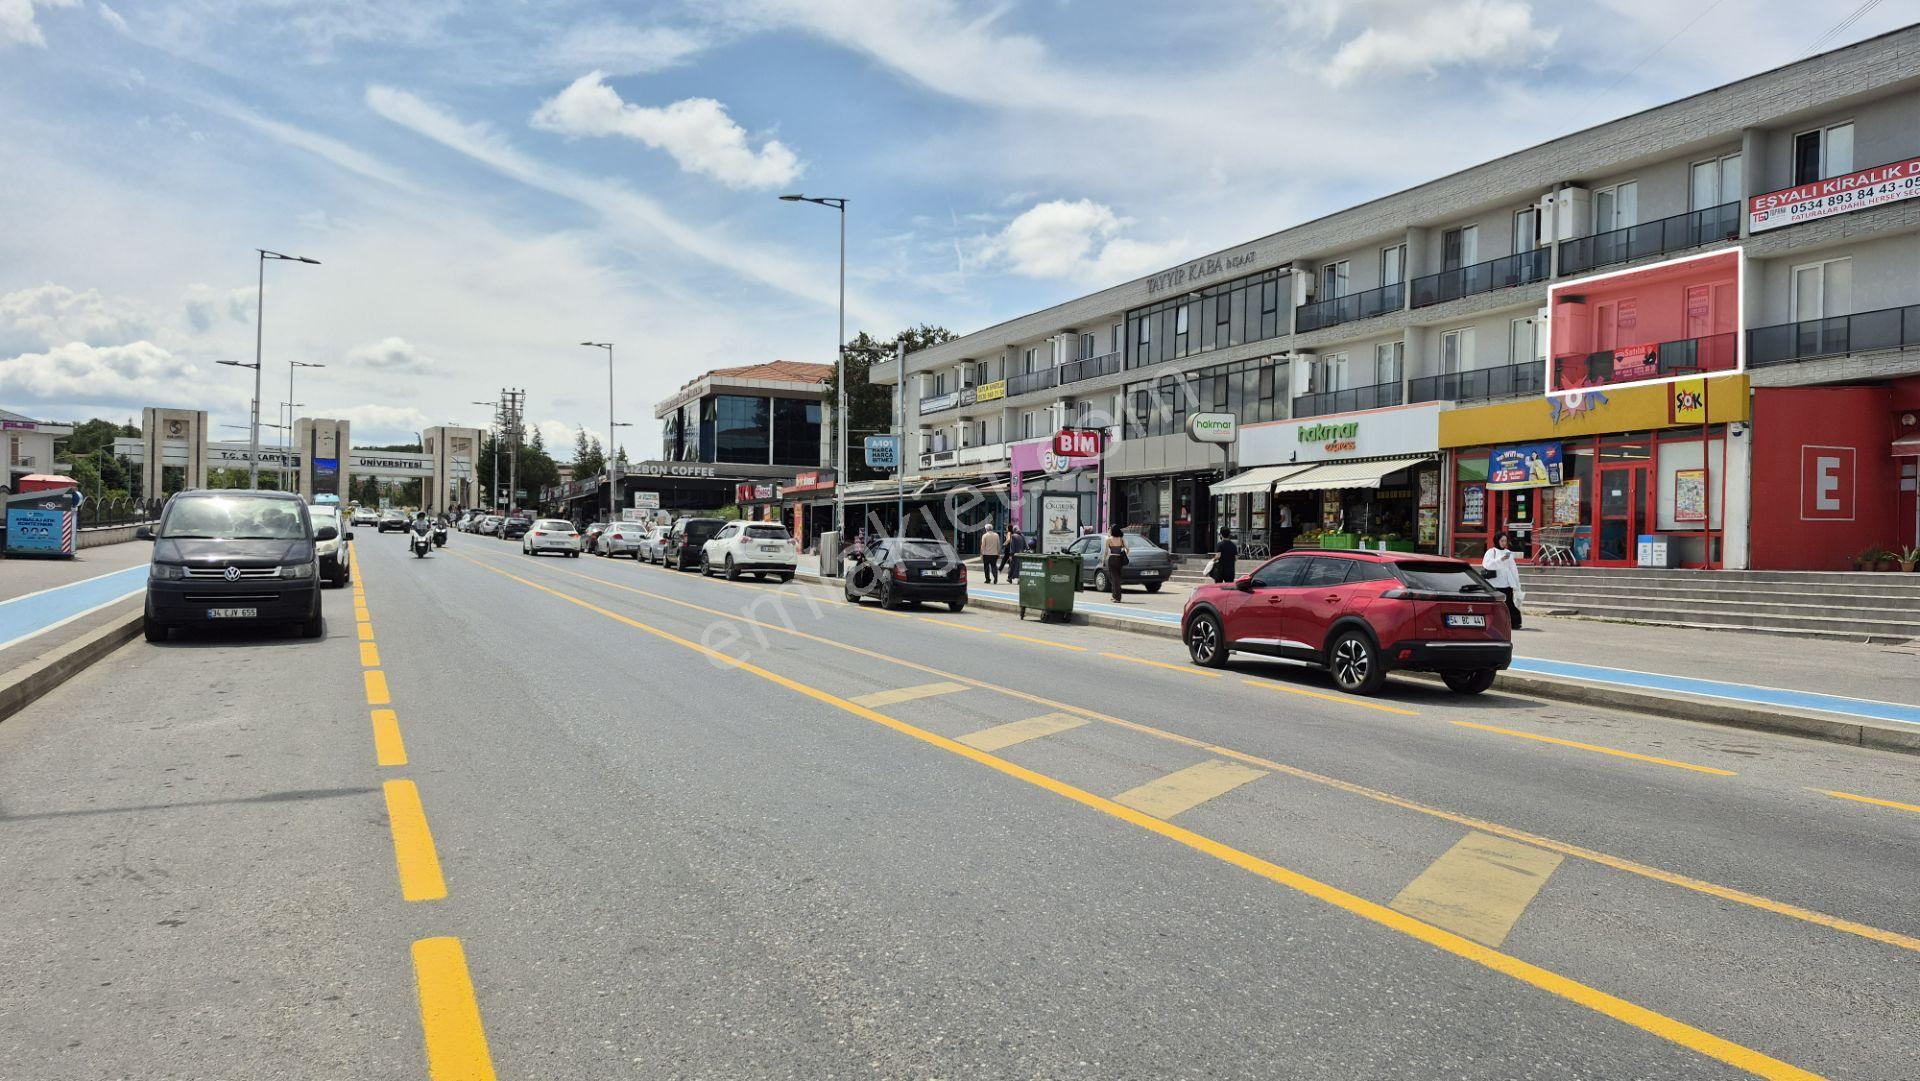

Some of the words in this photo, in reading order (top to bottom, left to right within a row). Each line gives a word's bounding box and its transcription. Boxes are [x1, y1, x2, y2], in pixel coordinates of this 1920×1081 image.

[1755, 187, 1817, 209] EŞYALI
[1822, 166, 1902, 194] KİRALIK
[1791, 199, 1823, 214] 0534
[1827, 193, 1853, 207] 893
[1857, 187, 1875, 200] 84
[1791, 206, 1839, 222] FATURALAR
[1188, 259, 1224, 280] KABA
[1676, 392, 1703, 413] ŞOK
[1196, 420, 1232, 429] hakmar
[1297, 422, 1359, 442] hakmar
[242, 453, 289, 463] SKARY
[671, 466, 715, 477] COFFEE
[1495, 469, 1508, 482] 75
[1816, 456, 1840, 510] E
